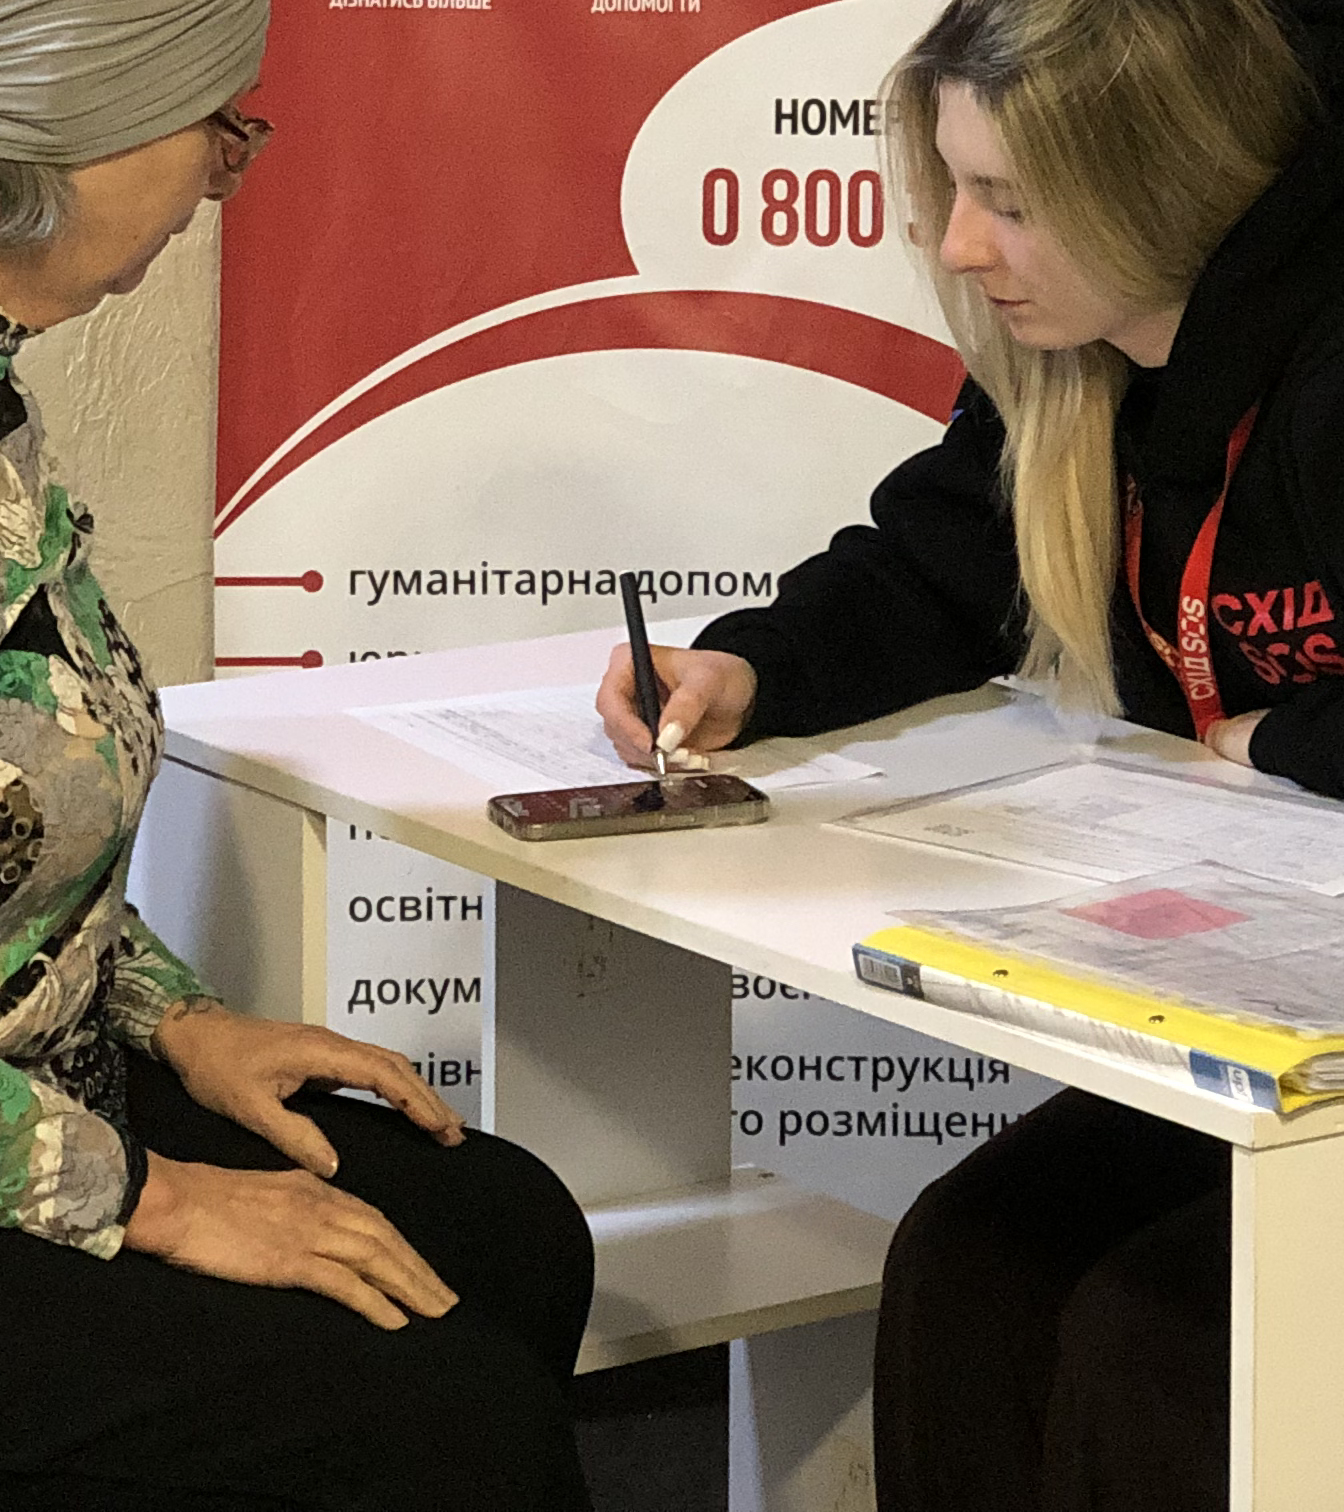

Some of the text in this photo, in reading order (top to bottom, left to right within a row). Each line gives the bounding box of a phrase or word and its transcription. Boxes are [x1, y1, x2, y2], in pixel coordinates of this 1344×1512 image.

[702, 167, 885, 248] 0 800
[348, 561, 781, 606] гуманітарна допом
[1211, 579, 1336, 637] СХІД
